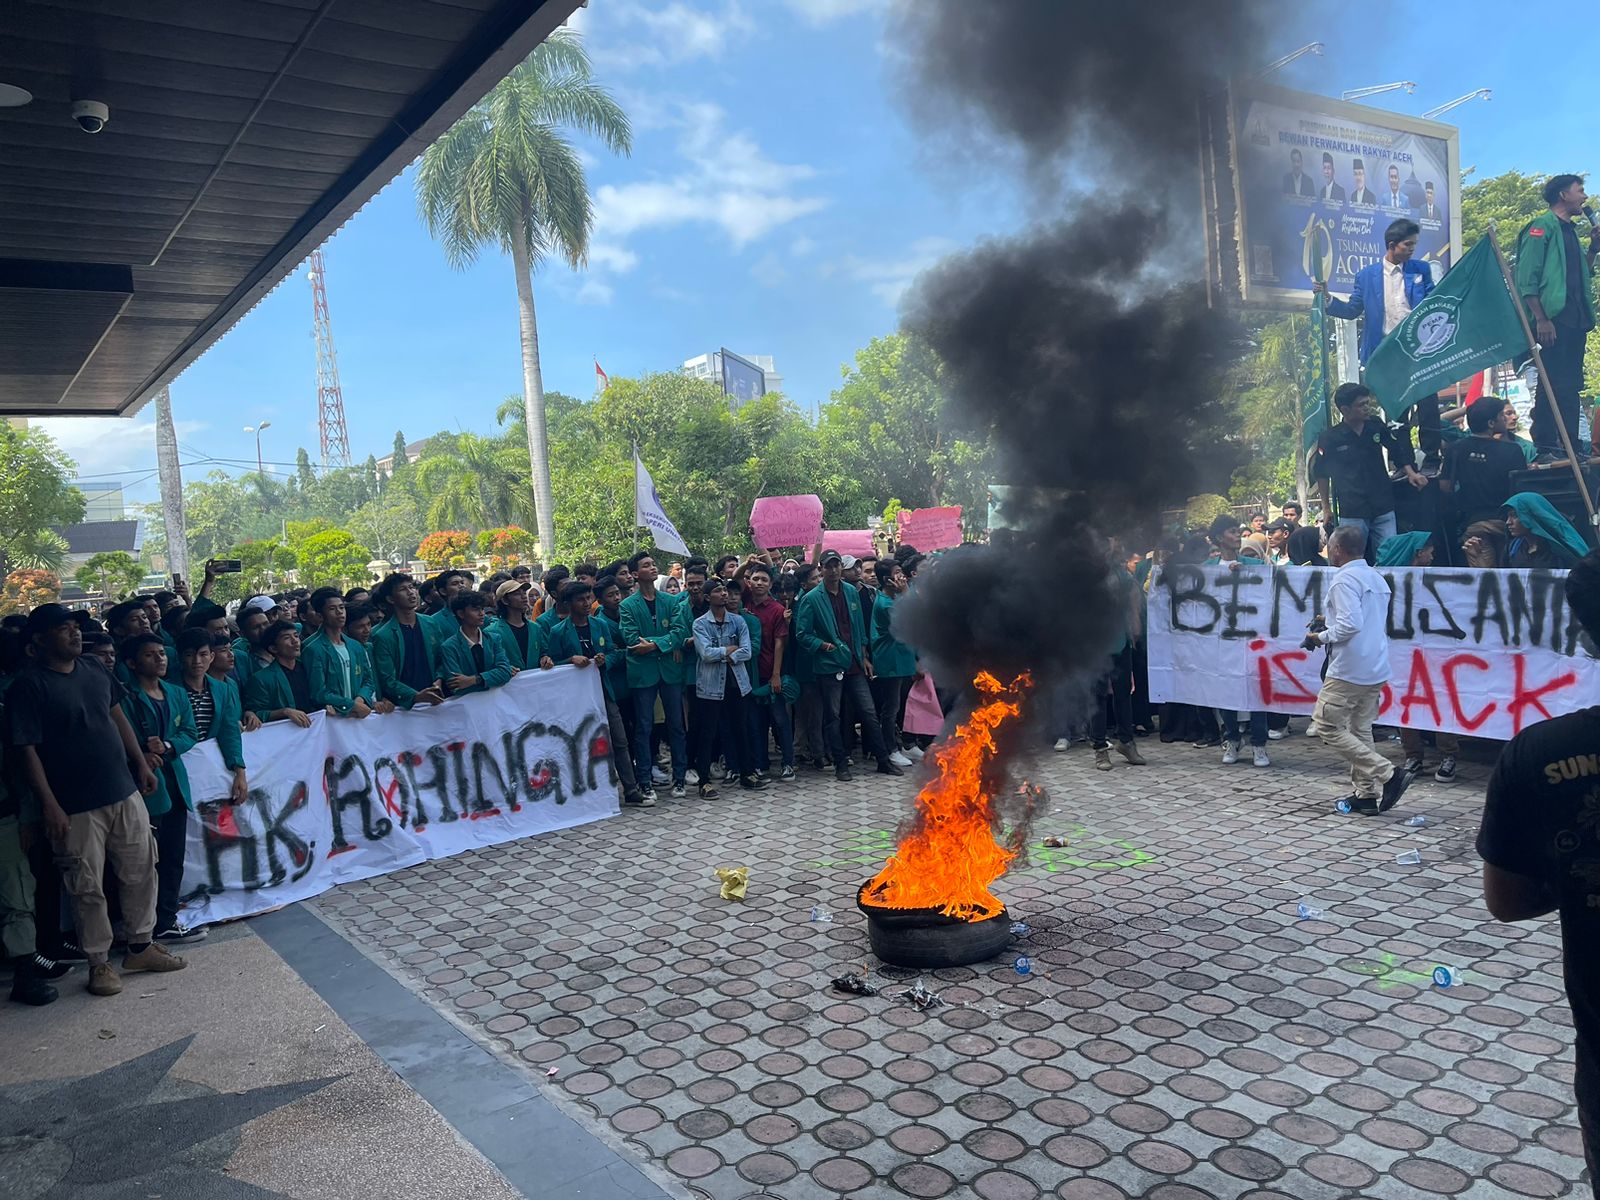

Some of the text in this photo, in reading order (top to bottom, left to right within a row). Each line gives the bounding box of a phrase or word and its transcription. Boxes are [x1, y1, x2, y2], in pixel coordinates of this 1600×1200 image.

[1279, 131, 1413, 164] DEWAN PERWAKILAN RAKYAT ACEH
[1336, 238, 1380, 256] TSUNAMI
[1422, 315, 1443, 328] PEMA
[1155, 565, 1323, 640] BEM
[322, 713, 619, 857] ROHINGYA
[1544, 753, 1600, 785] SUN
